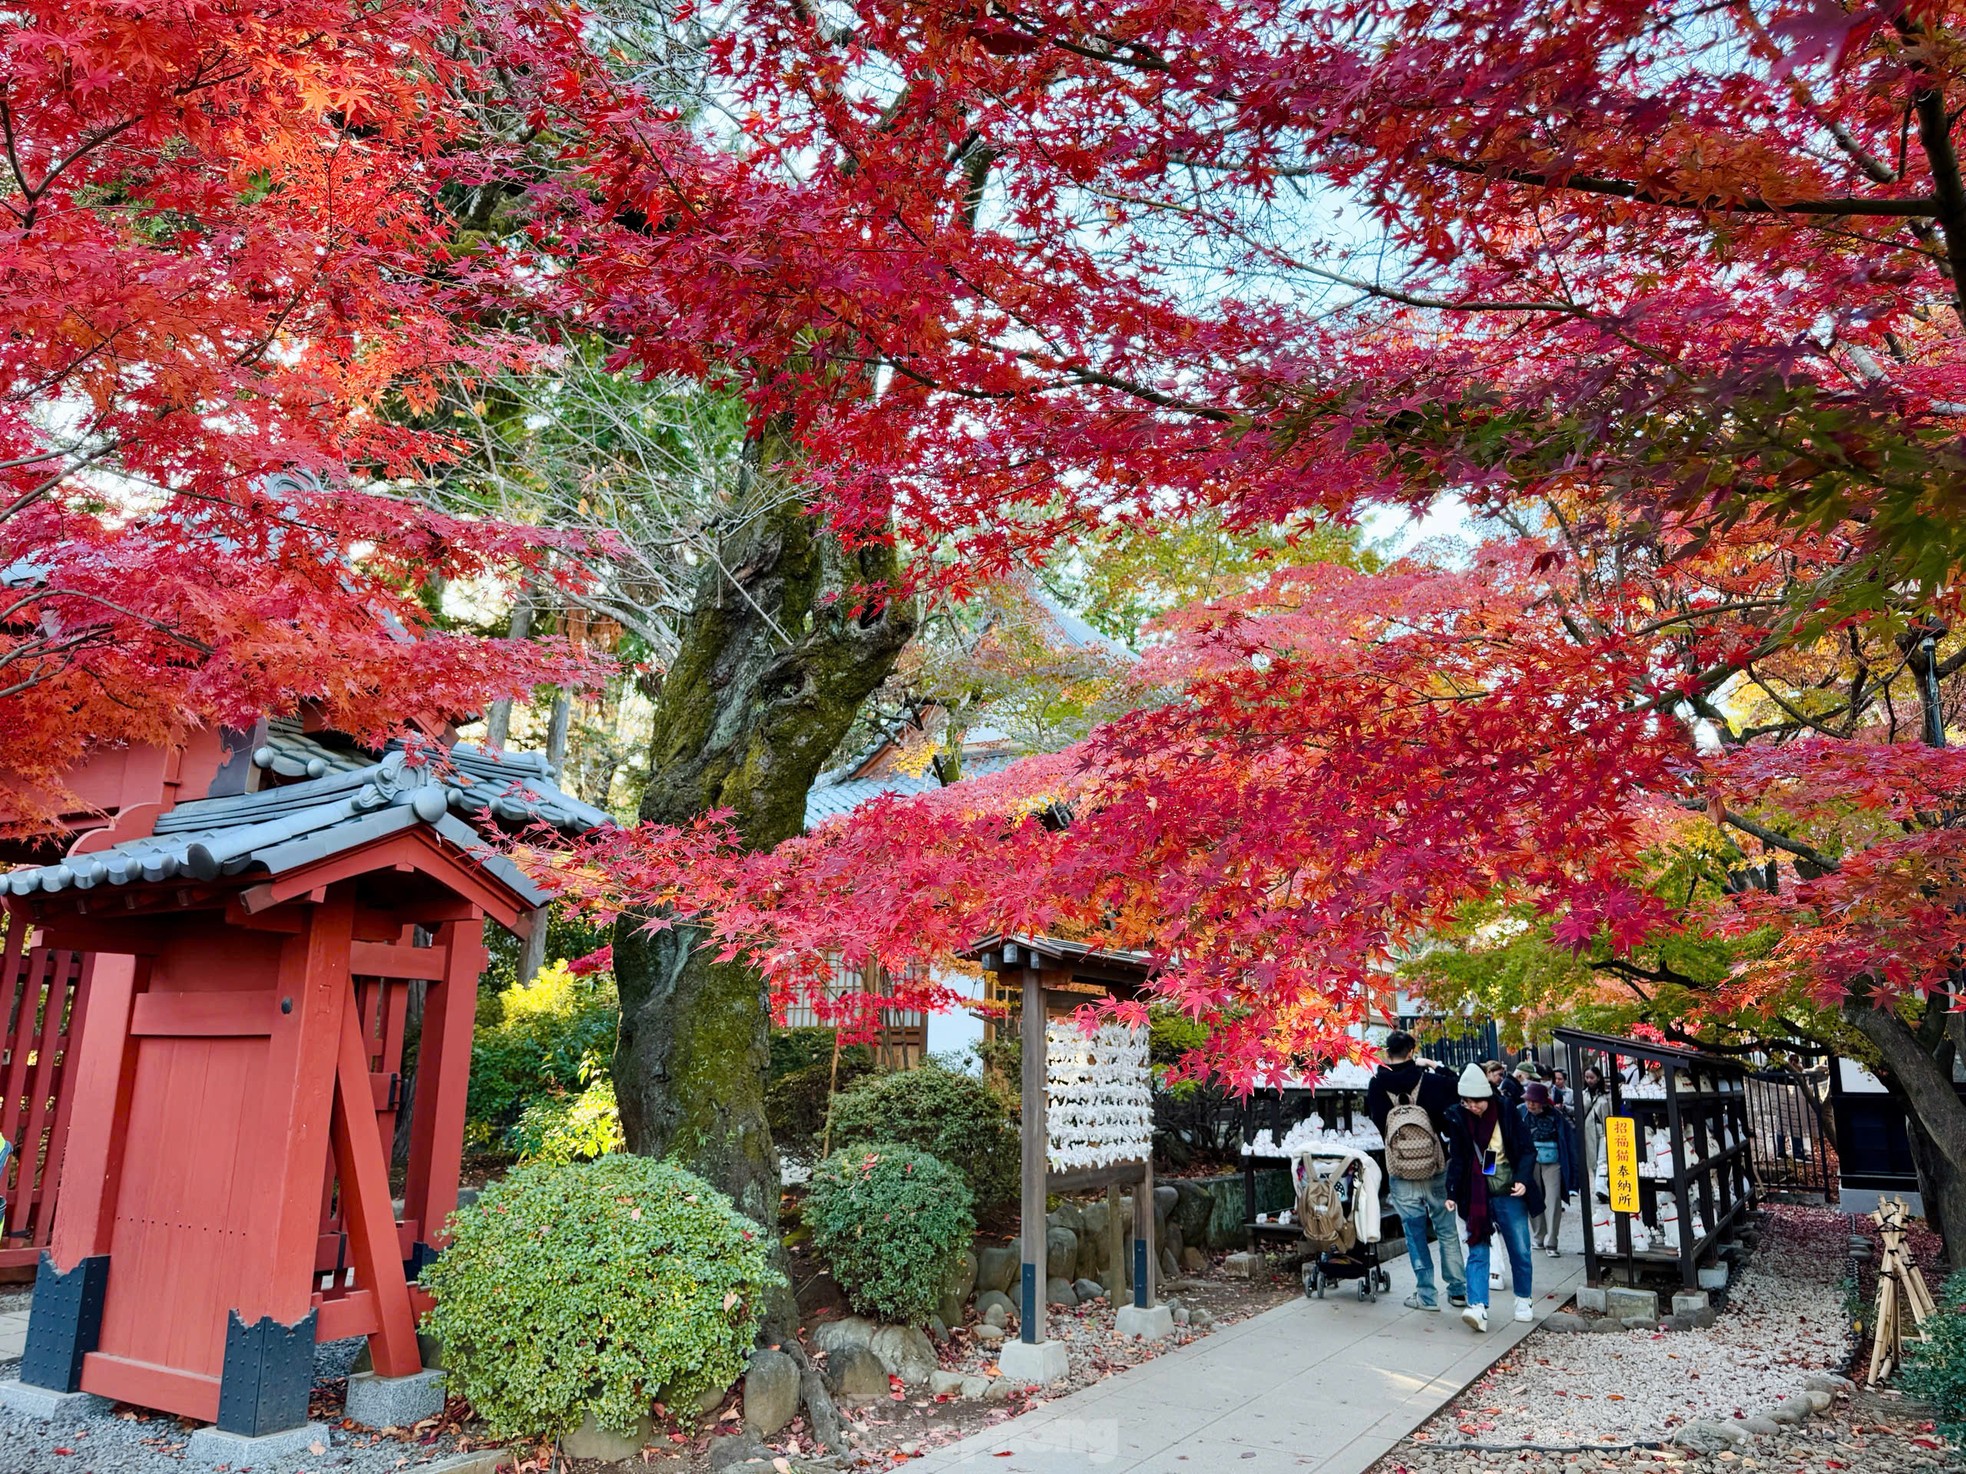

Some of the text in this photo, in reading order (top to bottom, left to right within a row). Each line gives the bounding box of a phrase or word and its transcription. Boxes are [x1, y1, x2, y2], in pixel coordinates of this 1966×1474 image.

[1615, 1121, 1632, 1207] 招福猫奉納所
